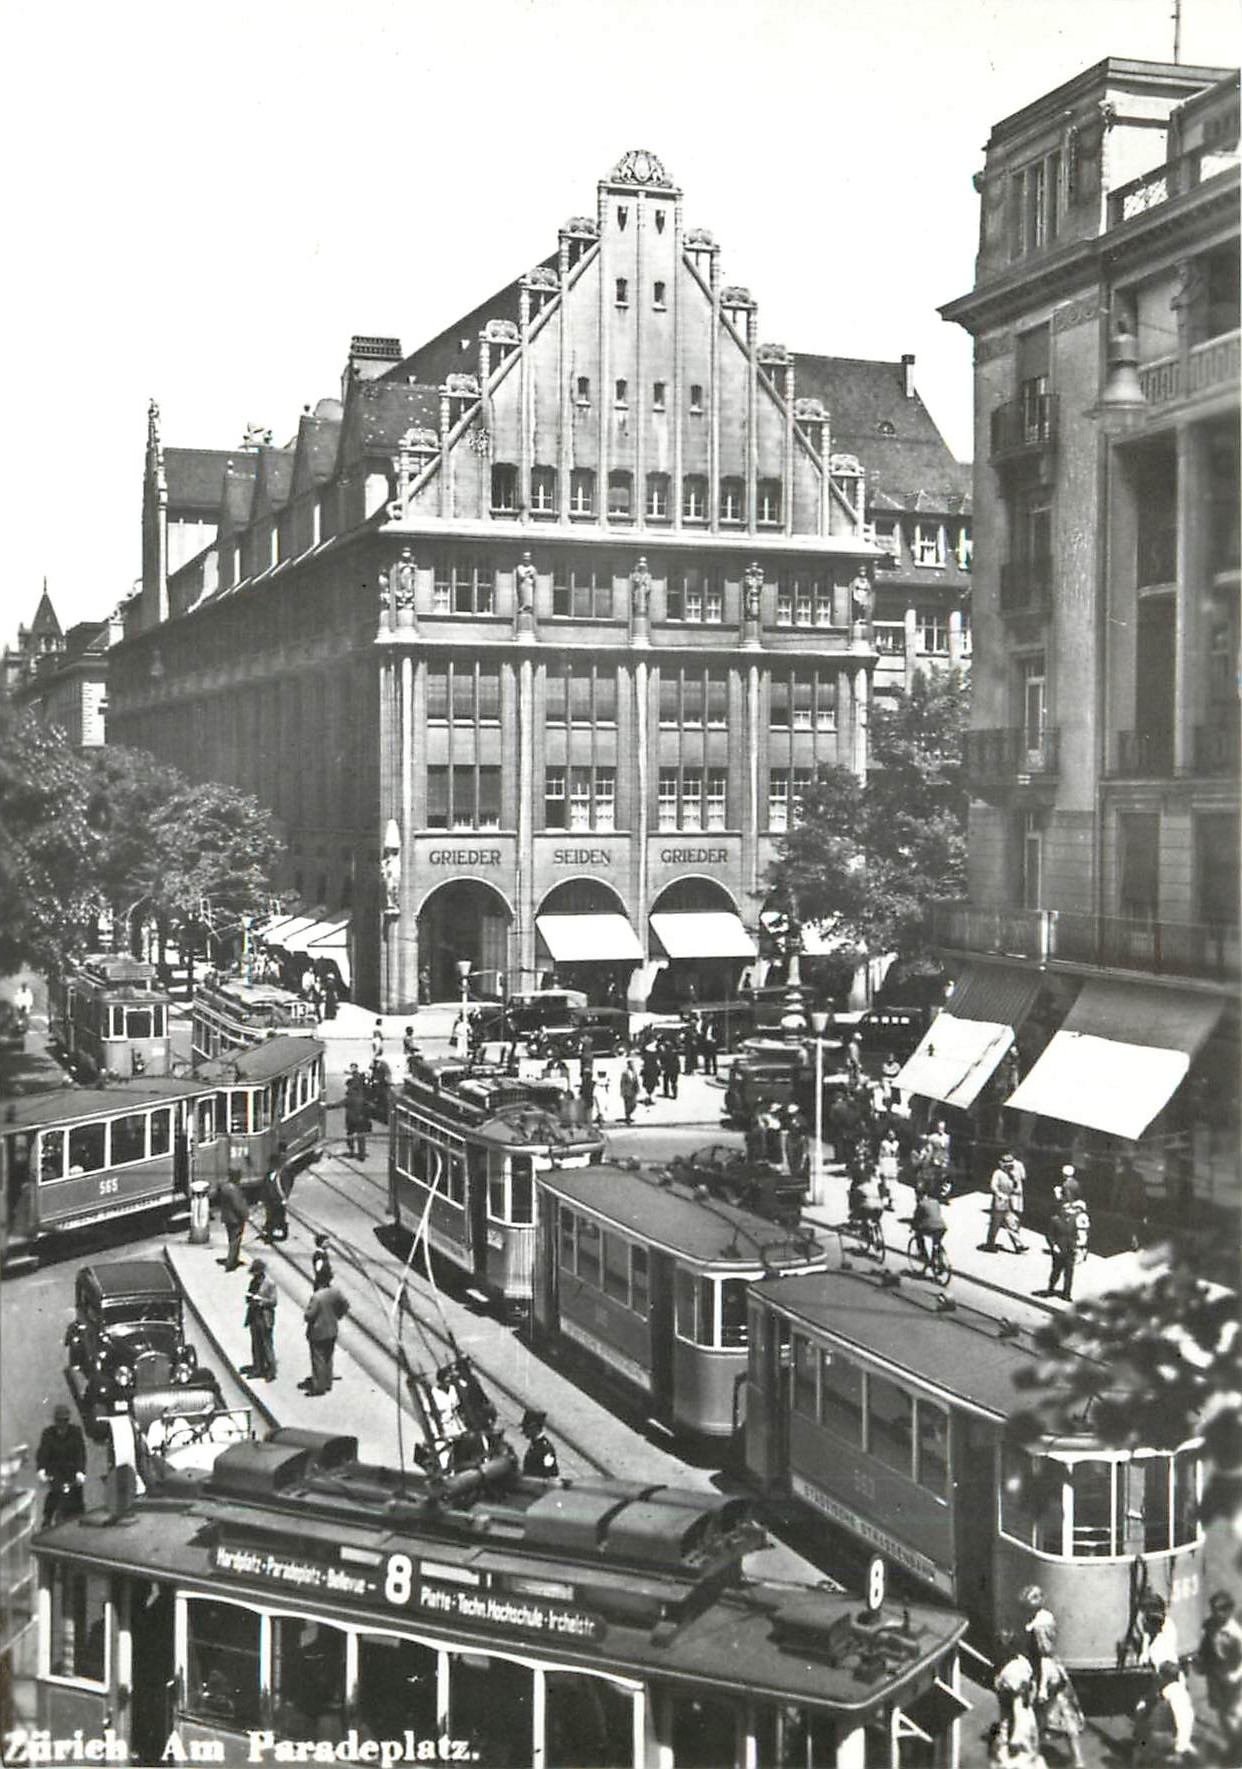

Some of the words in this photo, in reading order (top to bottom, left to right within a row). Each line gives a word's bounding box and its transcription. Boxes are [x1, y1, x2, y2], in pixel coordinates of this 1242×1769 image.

[428, 849, 501, 865] GRIEDER
[553, 849, 612, 867] SEIDEN
[660, 849, 729, 865] GRIEDER
[293, 1003, 307, 1017] 13
[99, 1178, 119, 1195] 565
[384, 1553, 412, 1605] 8
[869, 1558, 885, 1610] 8
